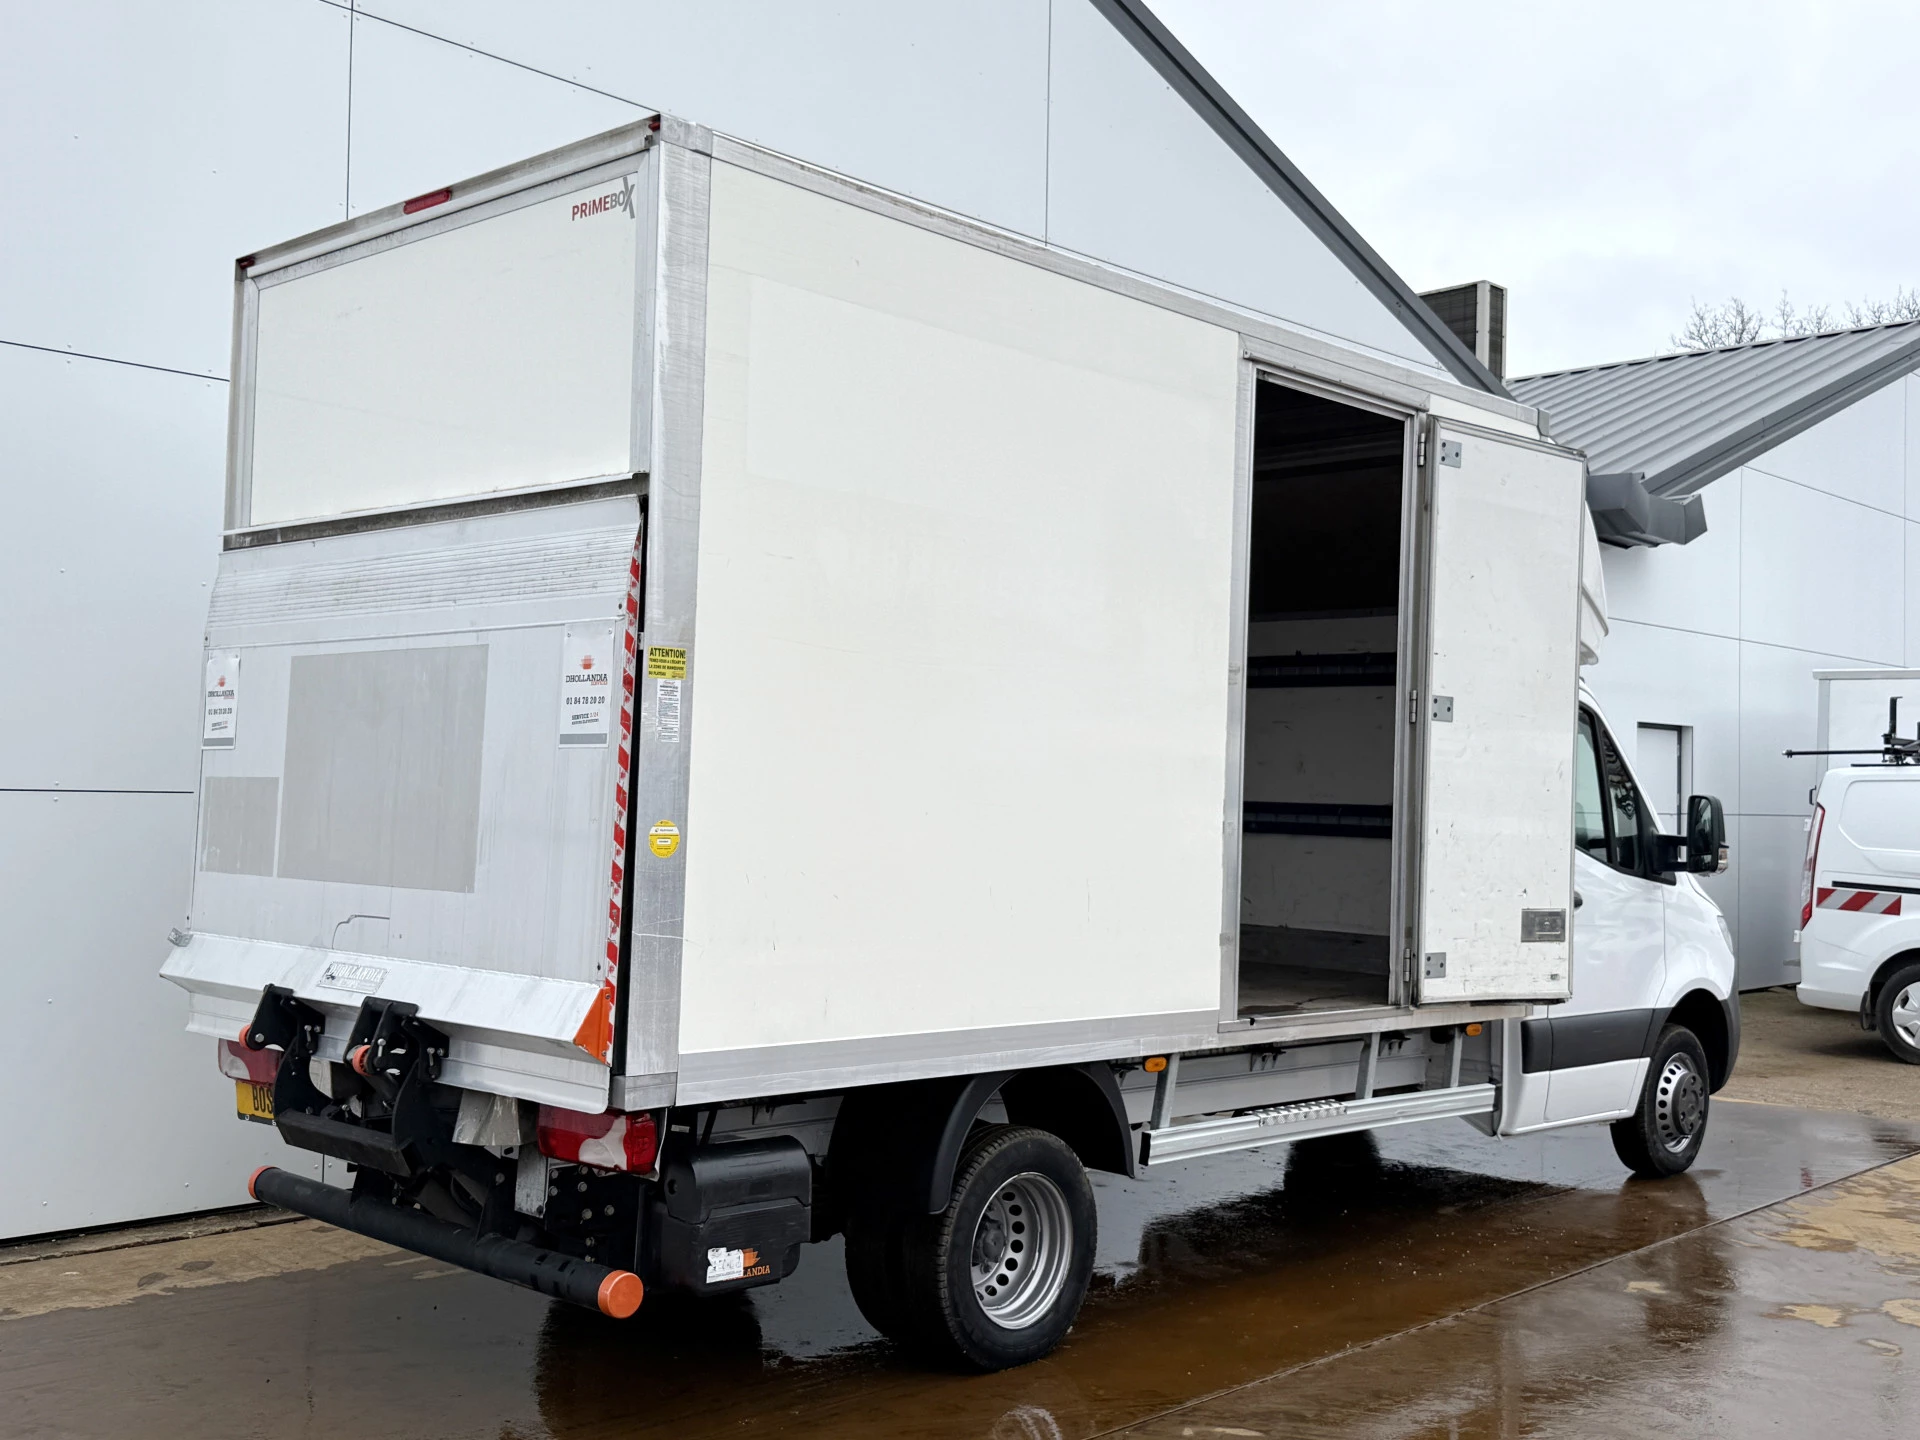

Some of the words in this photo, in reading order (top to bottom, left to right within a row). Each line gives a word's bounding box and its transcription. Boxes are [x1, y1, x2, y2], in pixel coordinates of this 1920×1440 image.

[649, 647, 686, 659] ATTENTION!
[565, 673, 608, 683] DHOLLANDIA
[566, 696, 573, 705] 01
[574, 696, 581, 705] 84
[582, 696, 589, 704] 78
[590, 696, 597, 704] 20
[598, 695, 605, 704] 20
[743, 1265, 771, 1277] LANDIA
